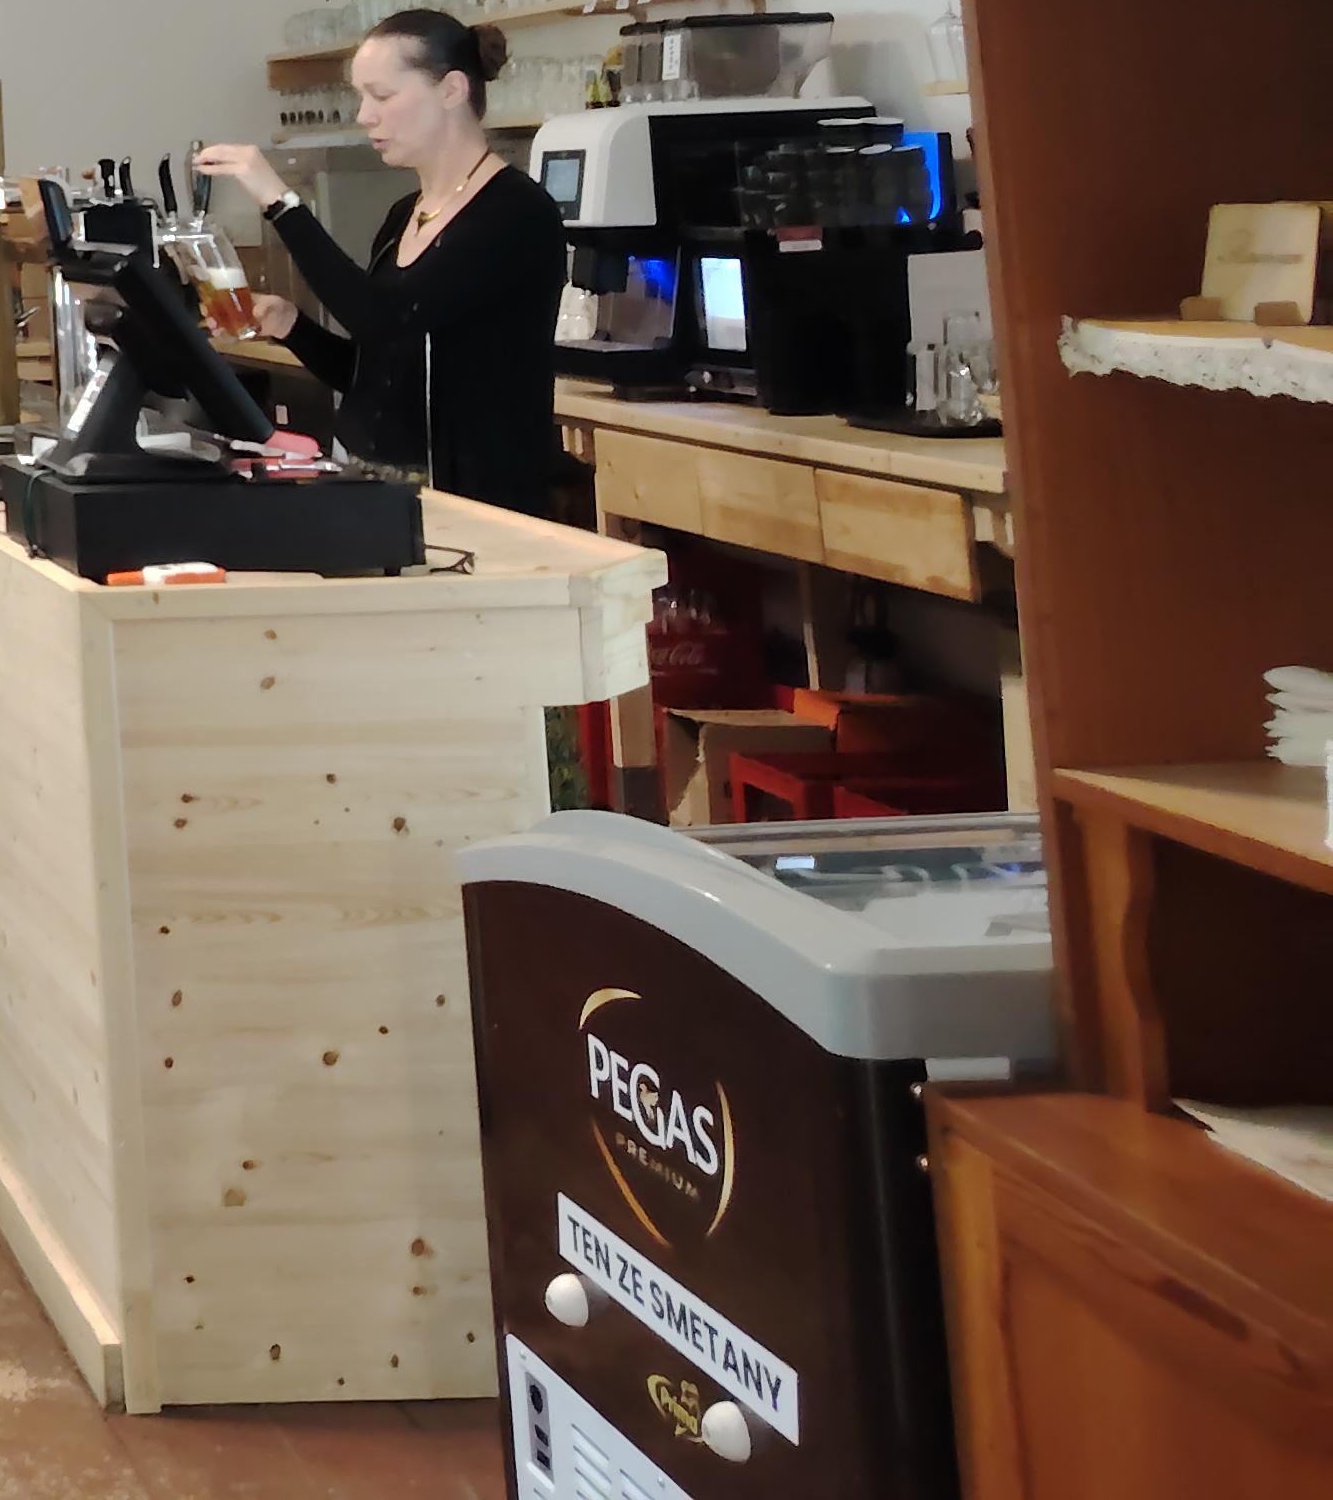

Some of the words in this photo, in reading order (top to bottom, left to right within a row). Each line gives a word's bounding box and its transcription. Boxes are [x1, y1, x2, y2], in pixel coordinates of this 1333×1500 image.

[588, 1033, 719, 1175] PEGAS
[567, 1214, 612, 1279] TEN
[616, 1254, 645, 1307] ZE
[649, 1280, 782, 1412] SMETANY
